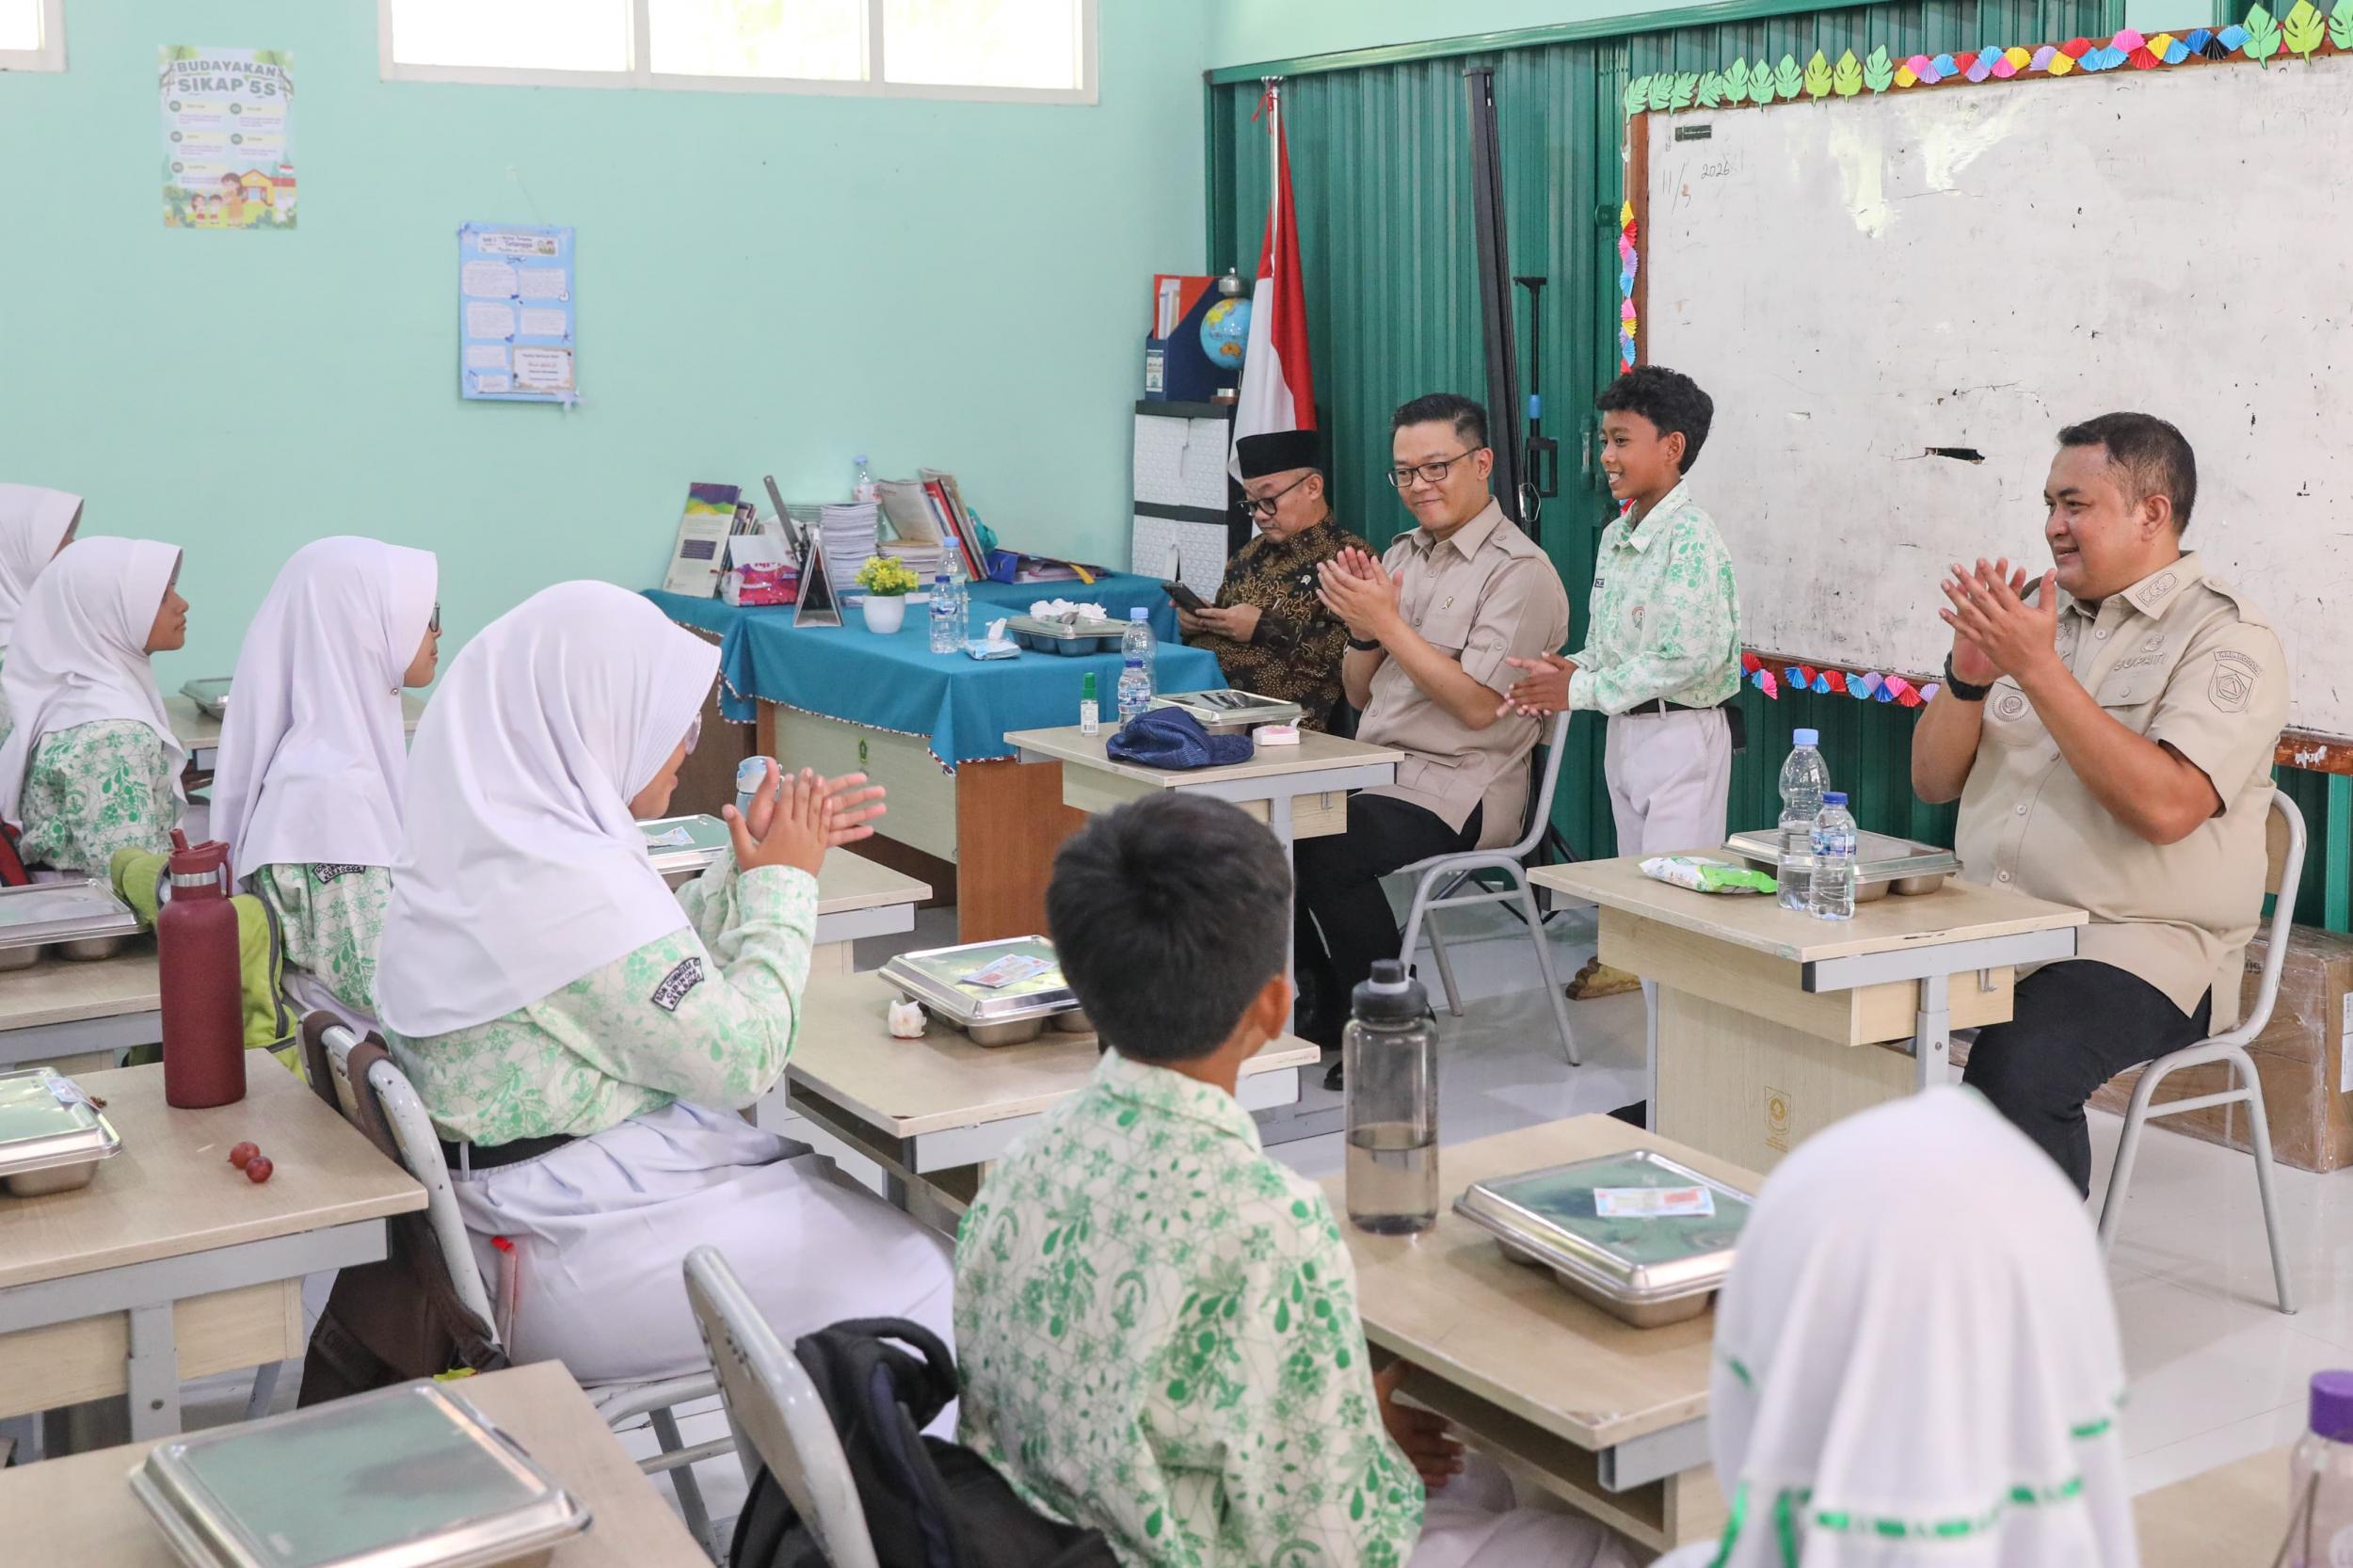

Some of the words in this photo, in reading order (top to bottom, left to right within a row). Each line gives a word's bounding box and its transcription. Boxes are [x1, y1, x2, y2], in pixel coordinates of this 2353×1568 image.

[177, 60, 277, 77] BUDAYAKAN
[178, 77, 244, 92] SIKAP
[249, 80, 277, 96] 5S
